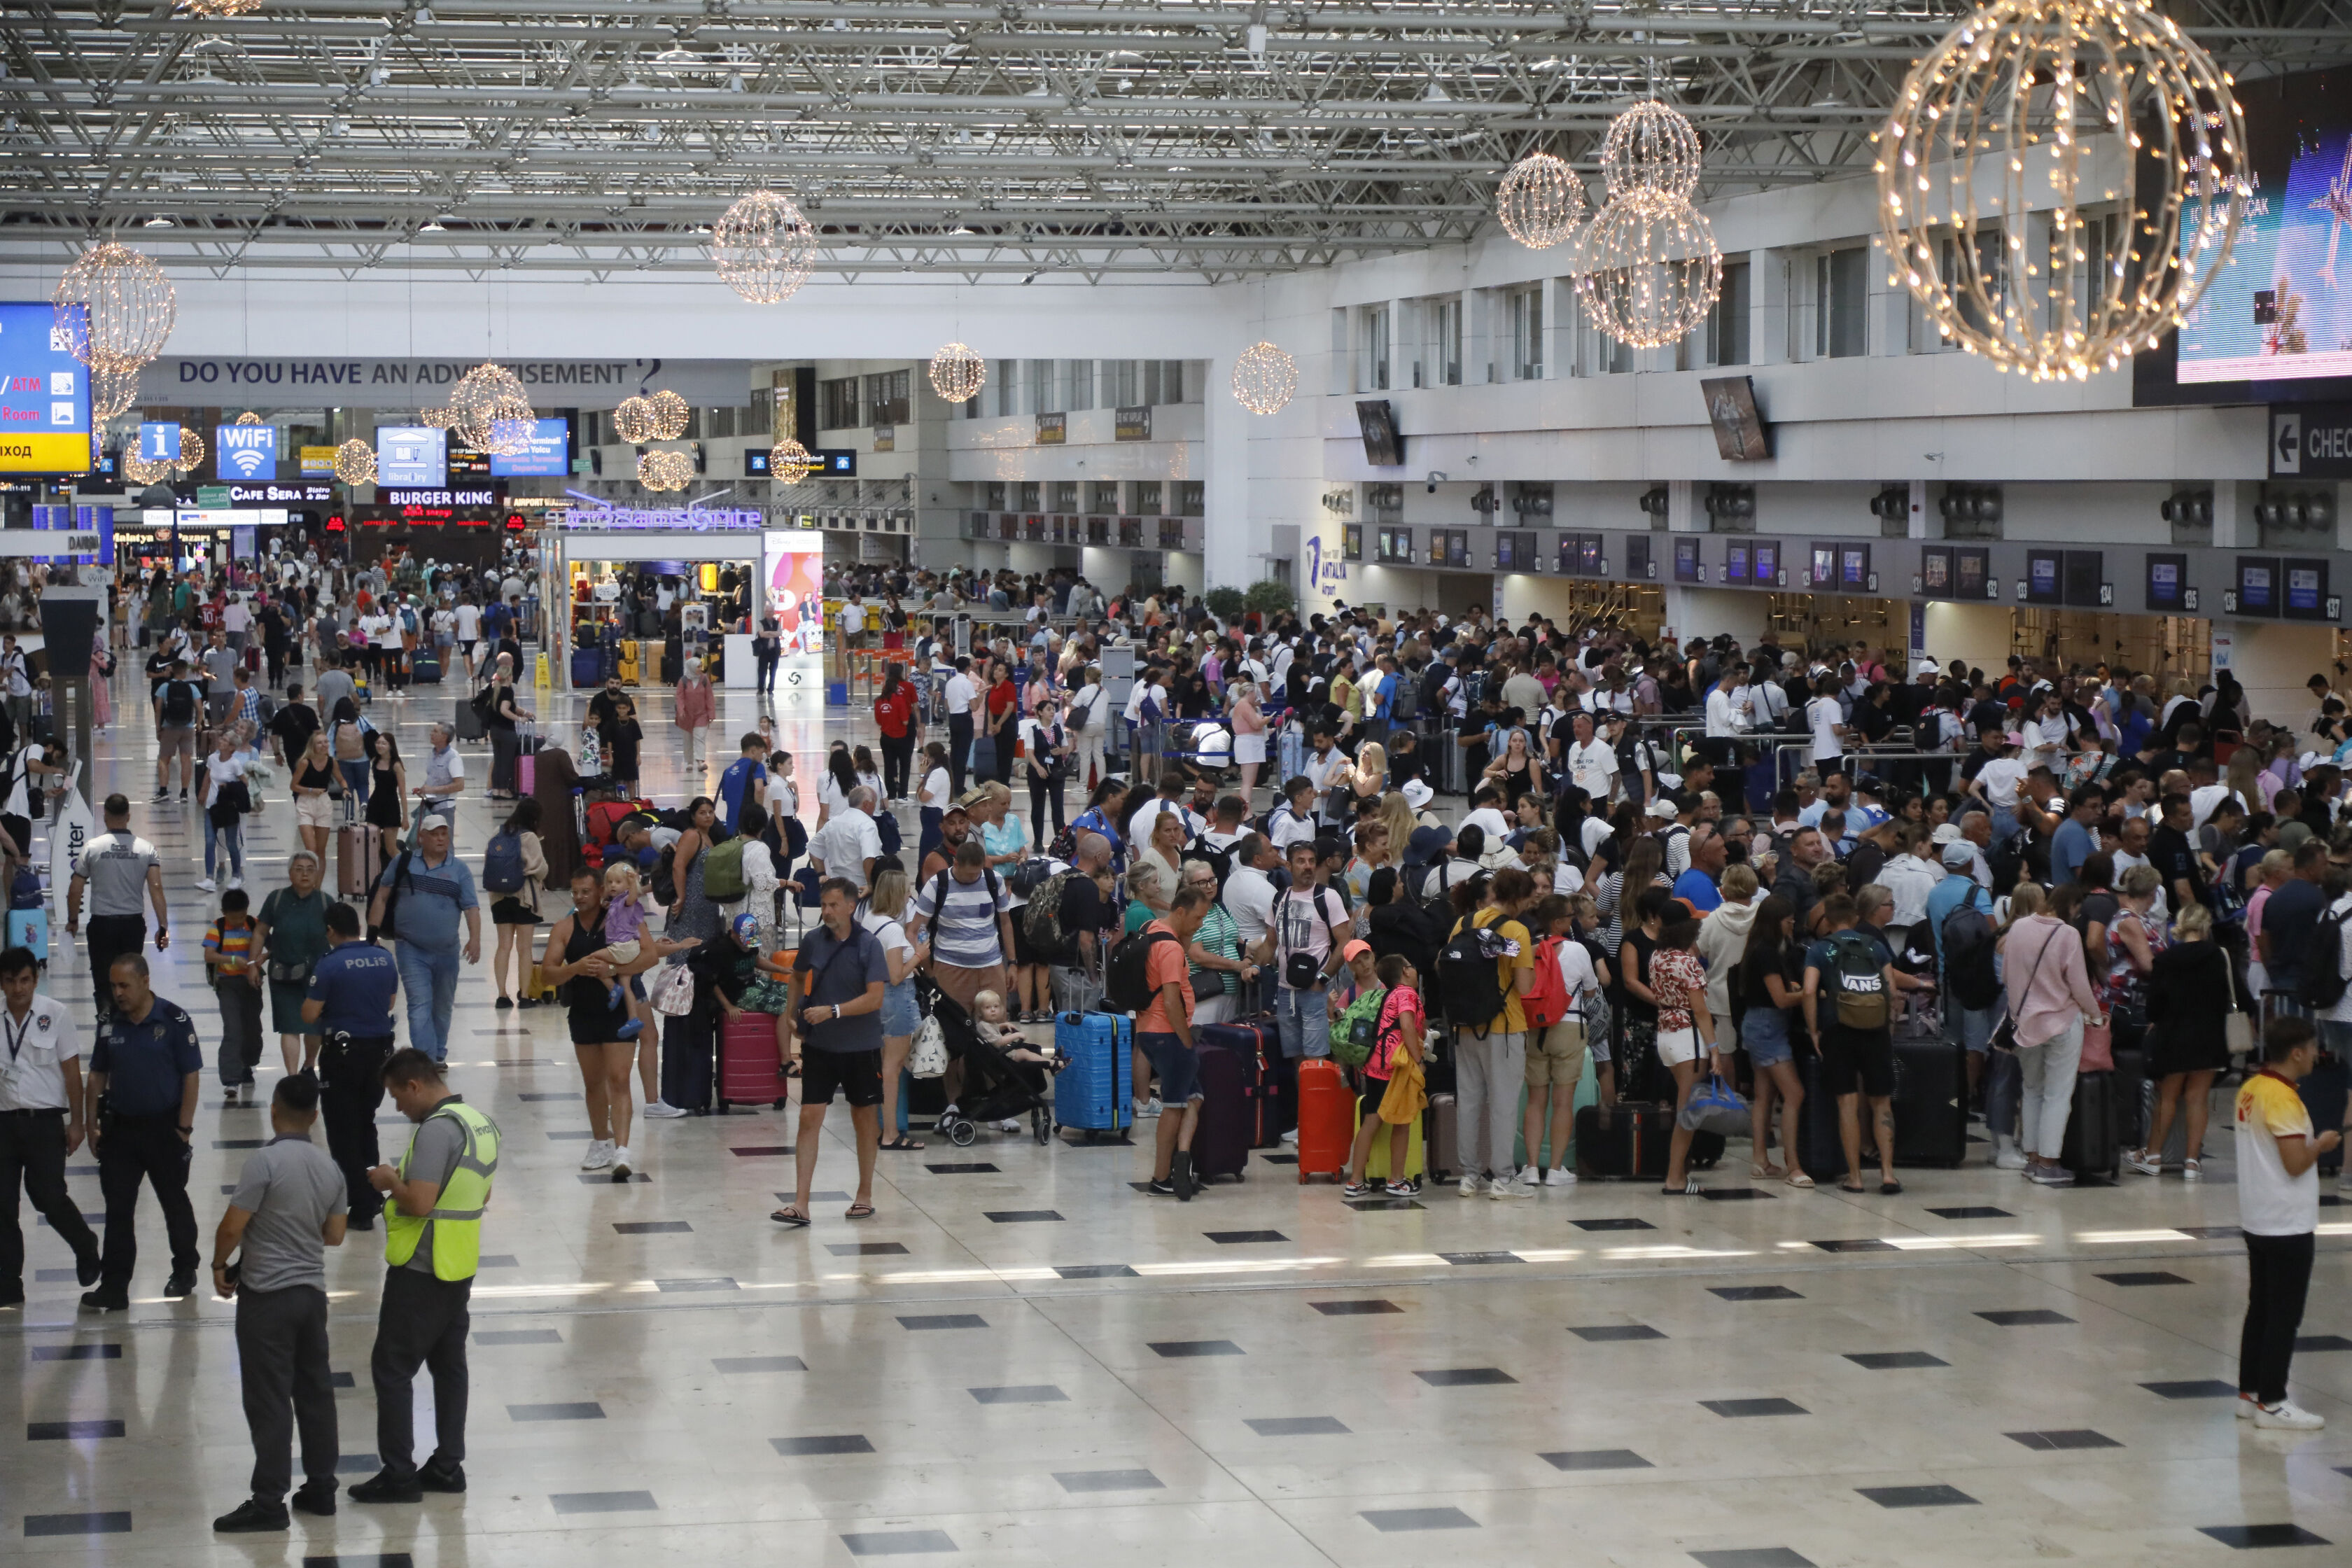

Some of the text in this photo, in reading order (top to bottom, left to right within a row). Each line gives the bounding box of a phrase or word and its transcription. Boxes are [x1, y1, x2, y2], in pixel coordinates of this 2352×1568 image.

[179, 362, 220, 383] DO
[225, 363, 282, 384] YOU
[290, 363, 362, 384] HAVE
[371, 363, 407, 384] AN
[416, 363, 628, 384] ADVTISEMENT
[3, 407, 39, 421] Room
[225, 428, 272, 448] WiFi
[0, 446, 31, 458] ход
[231, 486, 302, 501] CAFE SERA
[390, 491, 493, 504] BURGER KING
[514, 498, 543, 507] AIRPORT
[146, 513, 172, 522] Change
[568, 507, 604, 519] House
[88, 573, 107, 582] WiFi
[1322, 562, 1347, 580] ANTALYA
[1913, 576, 1922, 593] 131
[1987, 580, 1997, 597] 132
[2017, 582, 2027, 599] 133
[2101, 584, 2112, 603] 134
[2185, 589, 2197, 609] 135
[2224, 592, 2236, 612] 136
[2326, 597, 2340, 618] 137
[202, 610, 214, 623] 10
[1840, 969, 1882, 992] VANS
